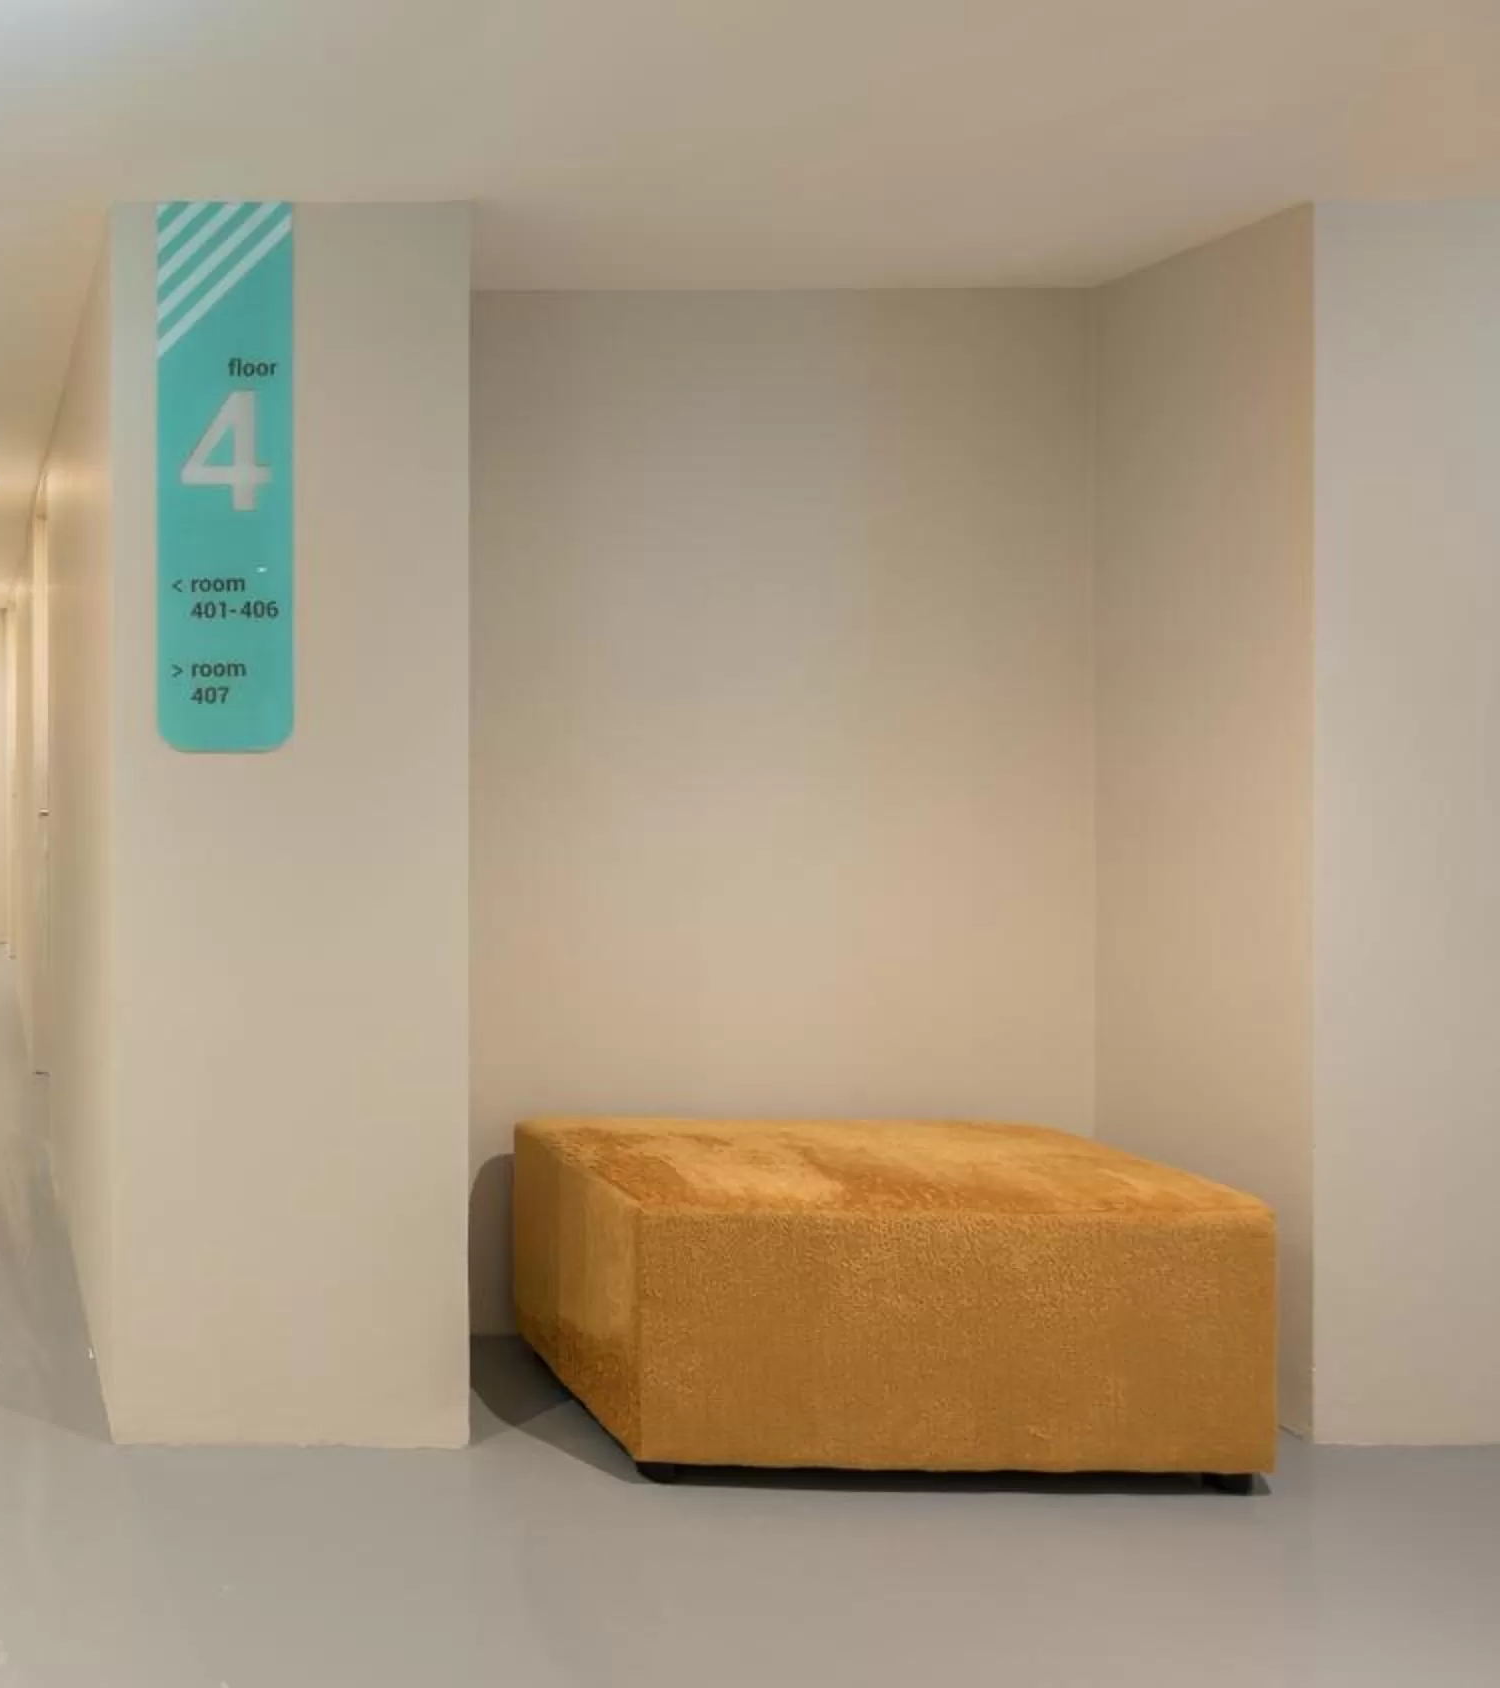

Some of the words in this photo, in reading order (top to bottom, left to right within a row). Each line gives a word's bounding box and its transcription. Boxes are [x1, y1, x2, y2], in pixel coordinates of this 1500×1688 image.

[227, 357, 278, 378] floor
[180, 389, 273, 512] 4
[190, 577, 246, 593] room
[190, 601, 279, 619] 401-406
[190, 662, 247, 678] room
[190, 687, 229, 705] 407
